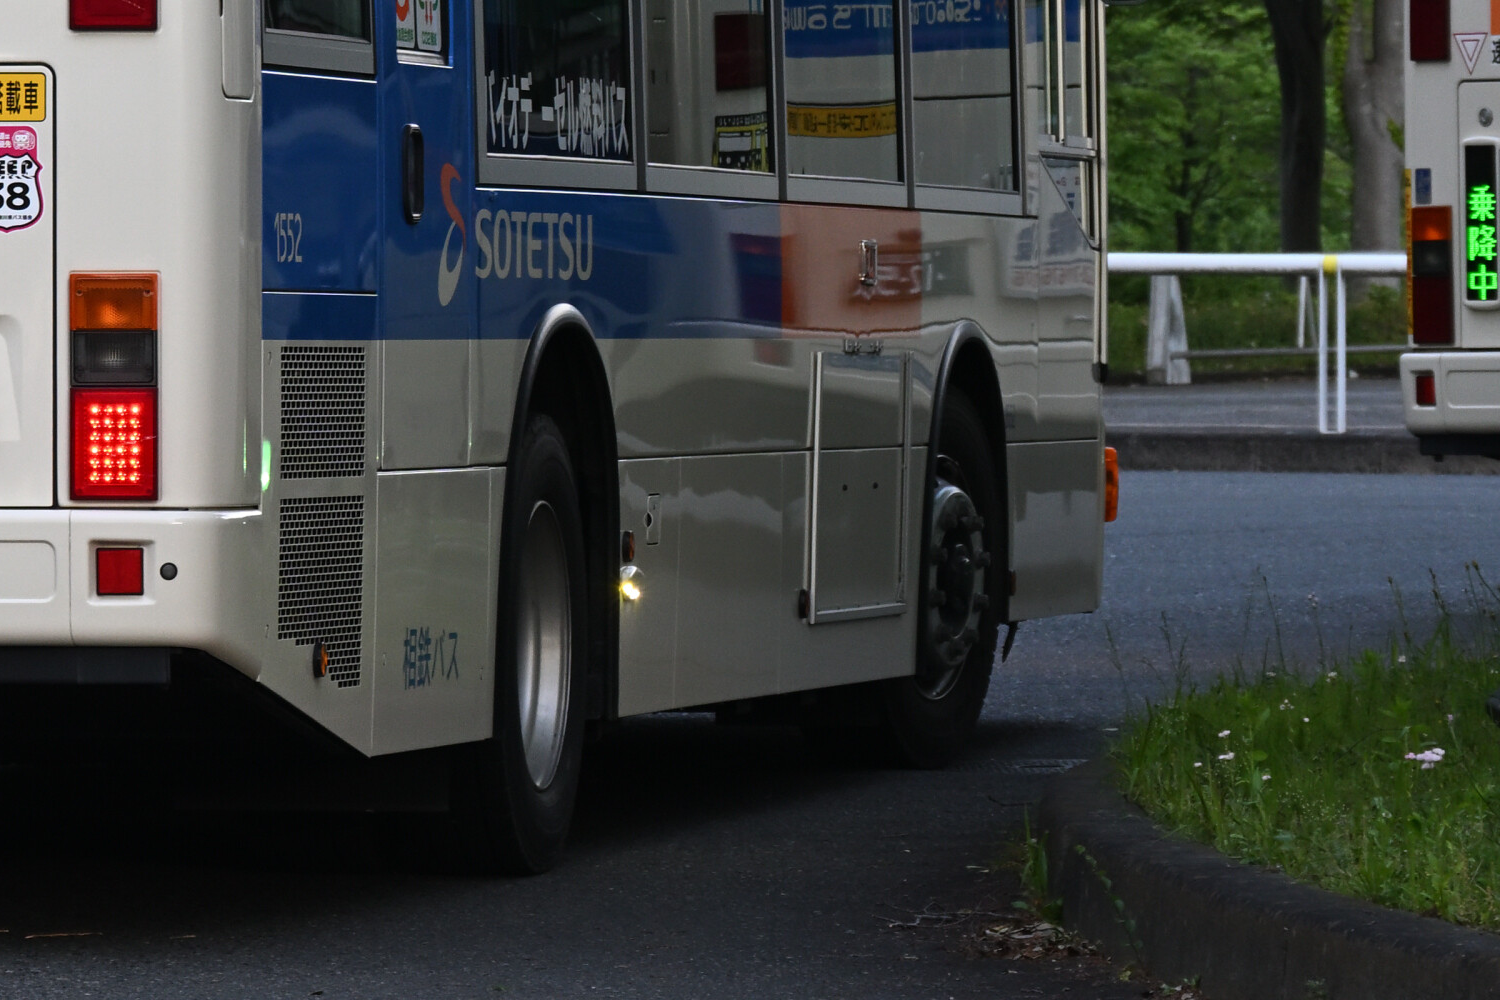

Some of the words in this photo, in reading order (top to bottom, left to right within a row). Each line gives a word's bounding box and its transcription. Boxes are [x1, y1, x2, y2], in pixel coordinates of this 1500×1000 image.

[274, 212, 303, 263] 1552
[474, 208, 594, 281] SOTETSU
[1467, 184, 1498, 301] 乗降中
